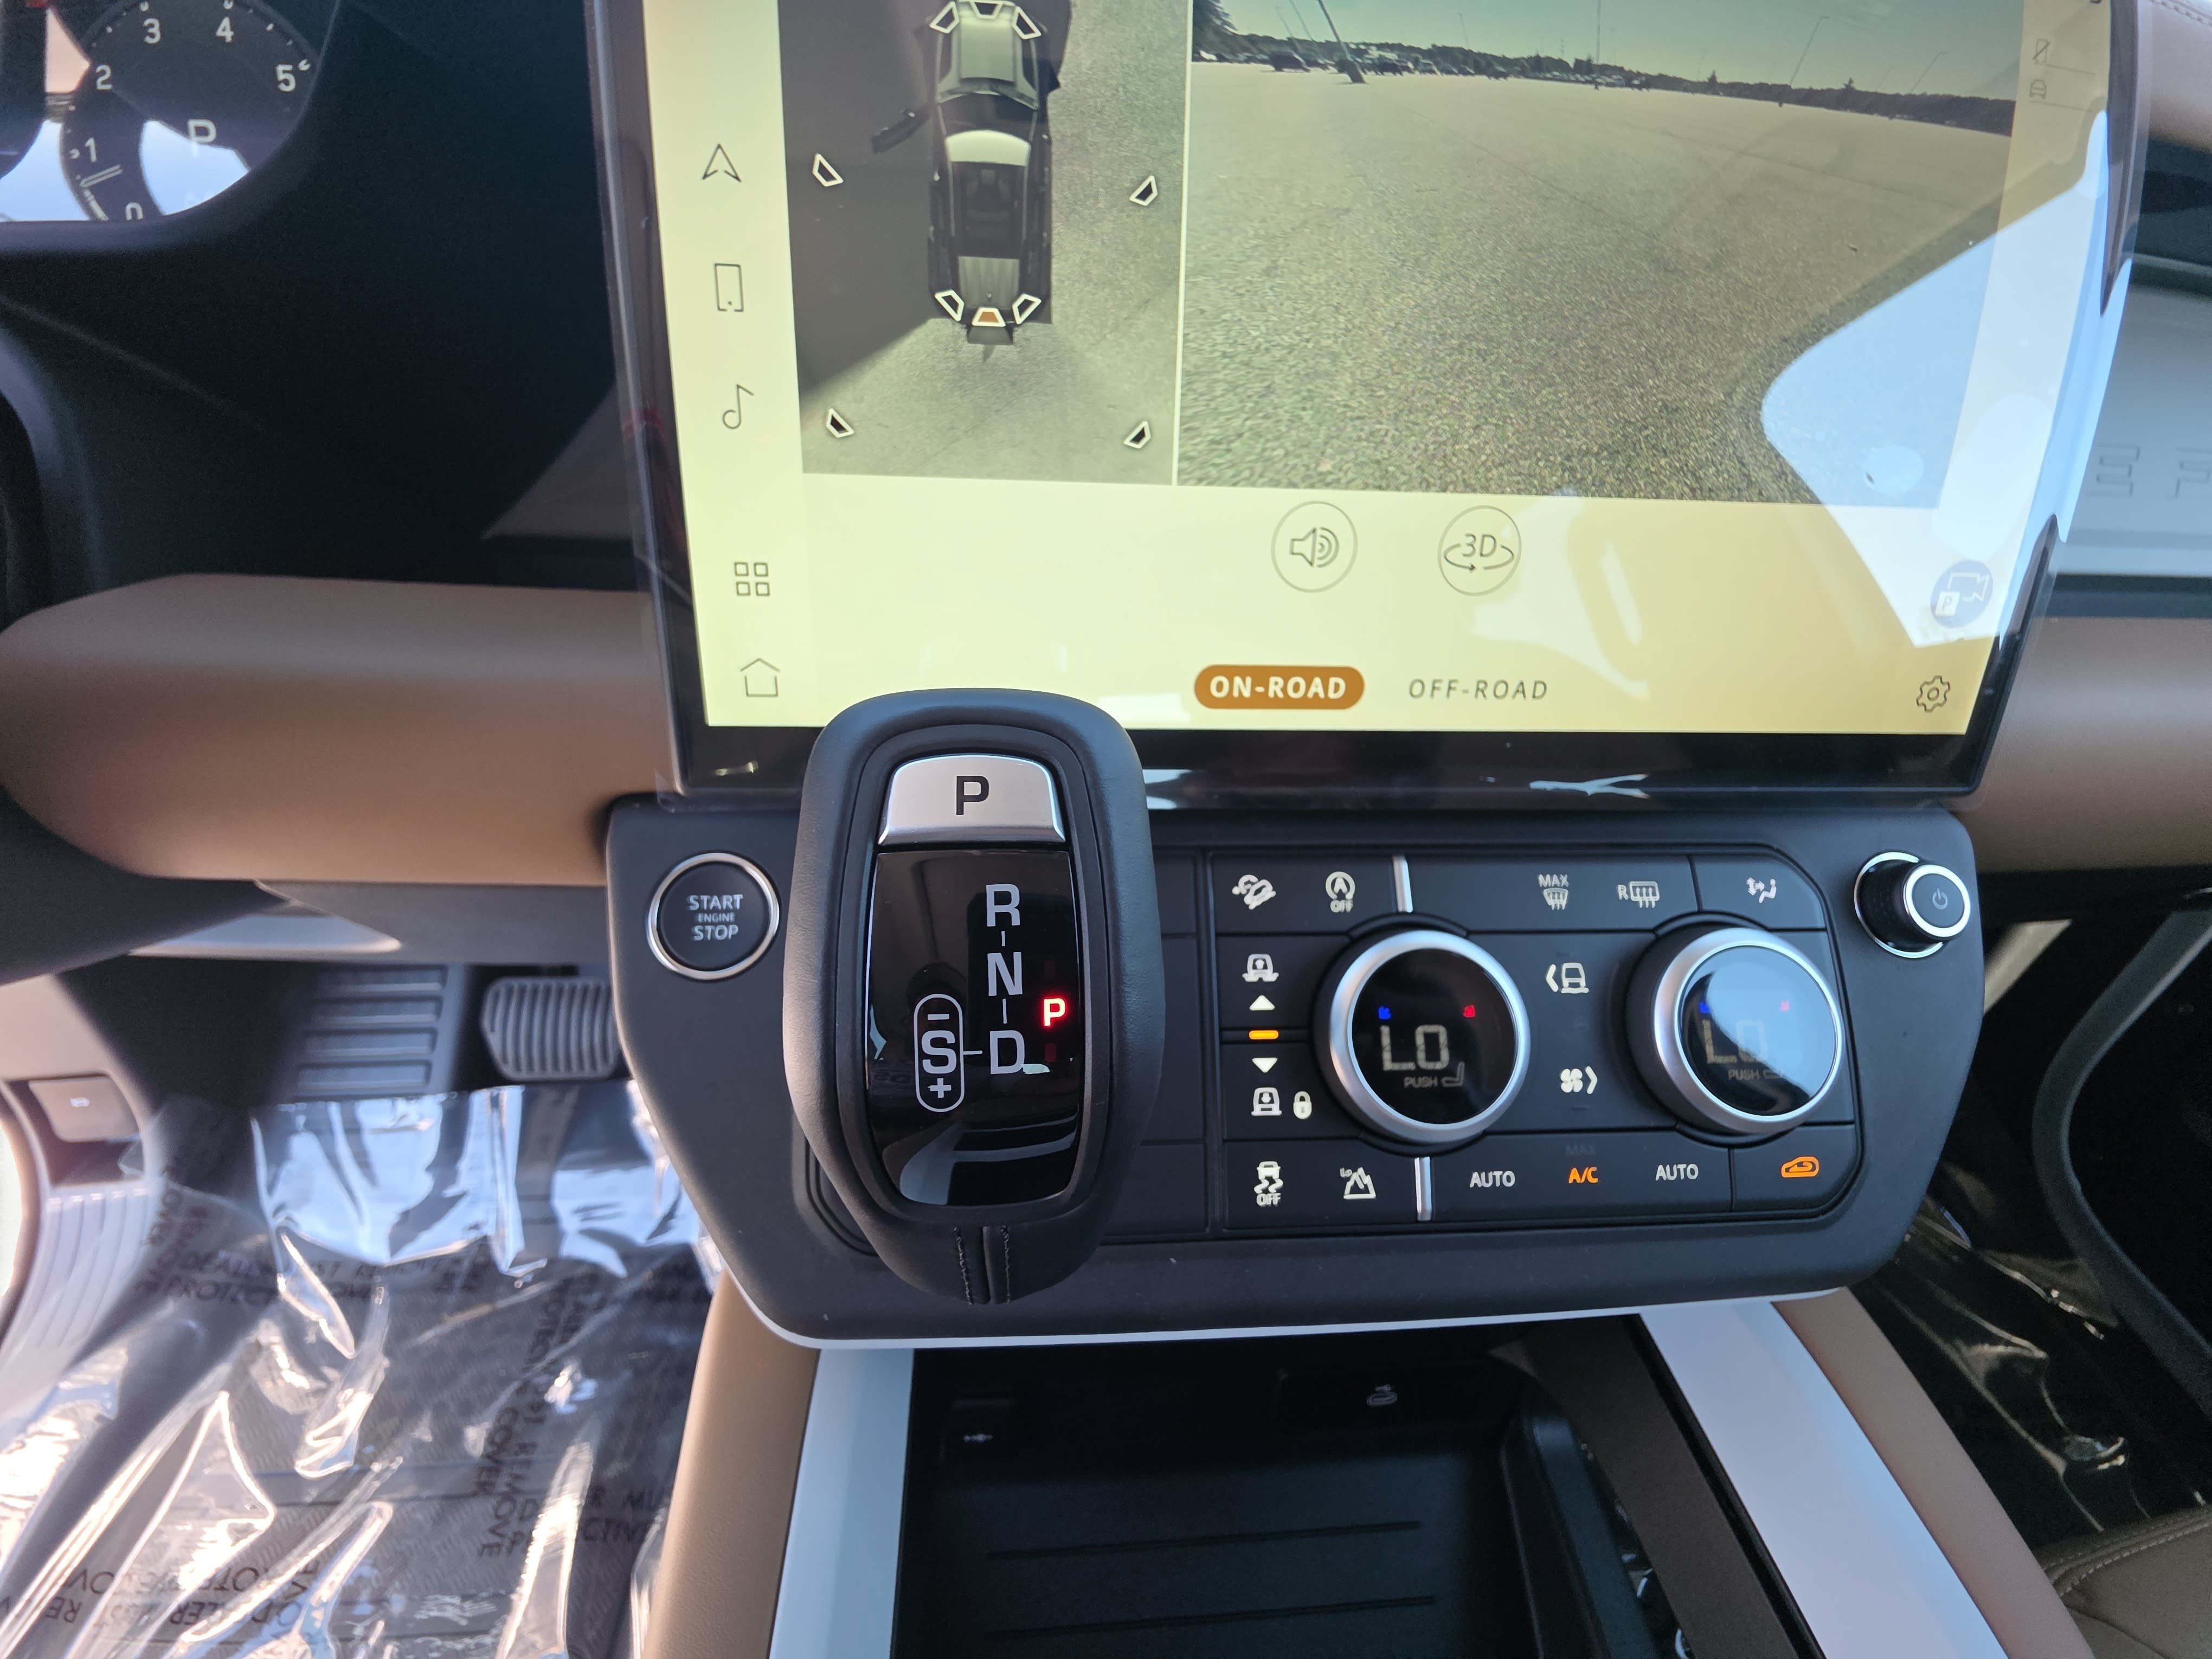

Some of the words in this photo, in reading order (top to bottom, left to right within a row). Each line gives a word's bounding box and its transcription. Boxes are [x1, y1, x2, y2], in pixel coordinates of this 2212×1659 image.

[144, 18, 162, 44] 3
[216, 17, 235, 43] 4
[96, 65, 113, 91] 2
[276, 65, 297, 92] 5
[85, 138, 98, 163] 1
[187, 119, 217, 158] P
[1462, 533, 1498, 558] 3D
[1210, 676, 1347, 700] ON-ROAD
[1409, 679, 1548, 701] OFF-ROAD
[956, 776, 990, 816] P
[1538, 874, 1570, 888] MAX
[1617, 884, 1629, 899] R
[689, 894, 744, 911] START
[986, 884, 1021, 928] R
[1330, 899, 1354, 913] OFF
[697, 912, 736, 923] ENGINE
[693, 924, 740, 942] STOP
[987, 952, 1024, 997] N
[1043, 996, 1068, 1027] P
[990, 1030, 1026, 1075] D
[1380, 1024, 1451, 1071] LO
[1404, 1076, 1438, 1089] PUSH
[1728, 1069, 1760, 1081] PUSH
[1470, 1171, 1516, 1188] AUTO
[1568, 1166, 1599, 1184] A/C
[1655, 1163, 1700, 1181] AUTO
[1256, 1193, 1282, 1207] OFF
